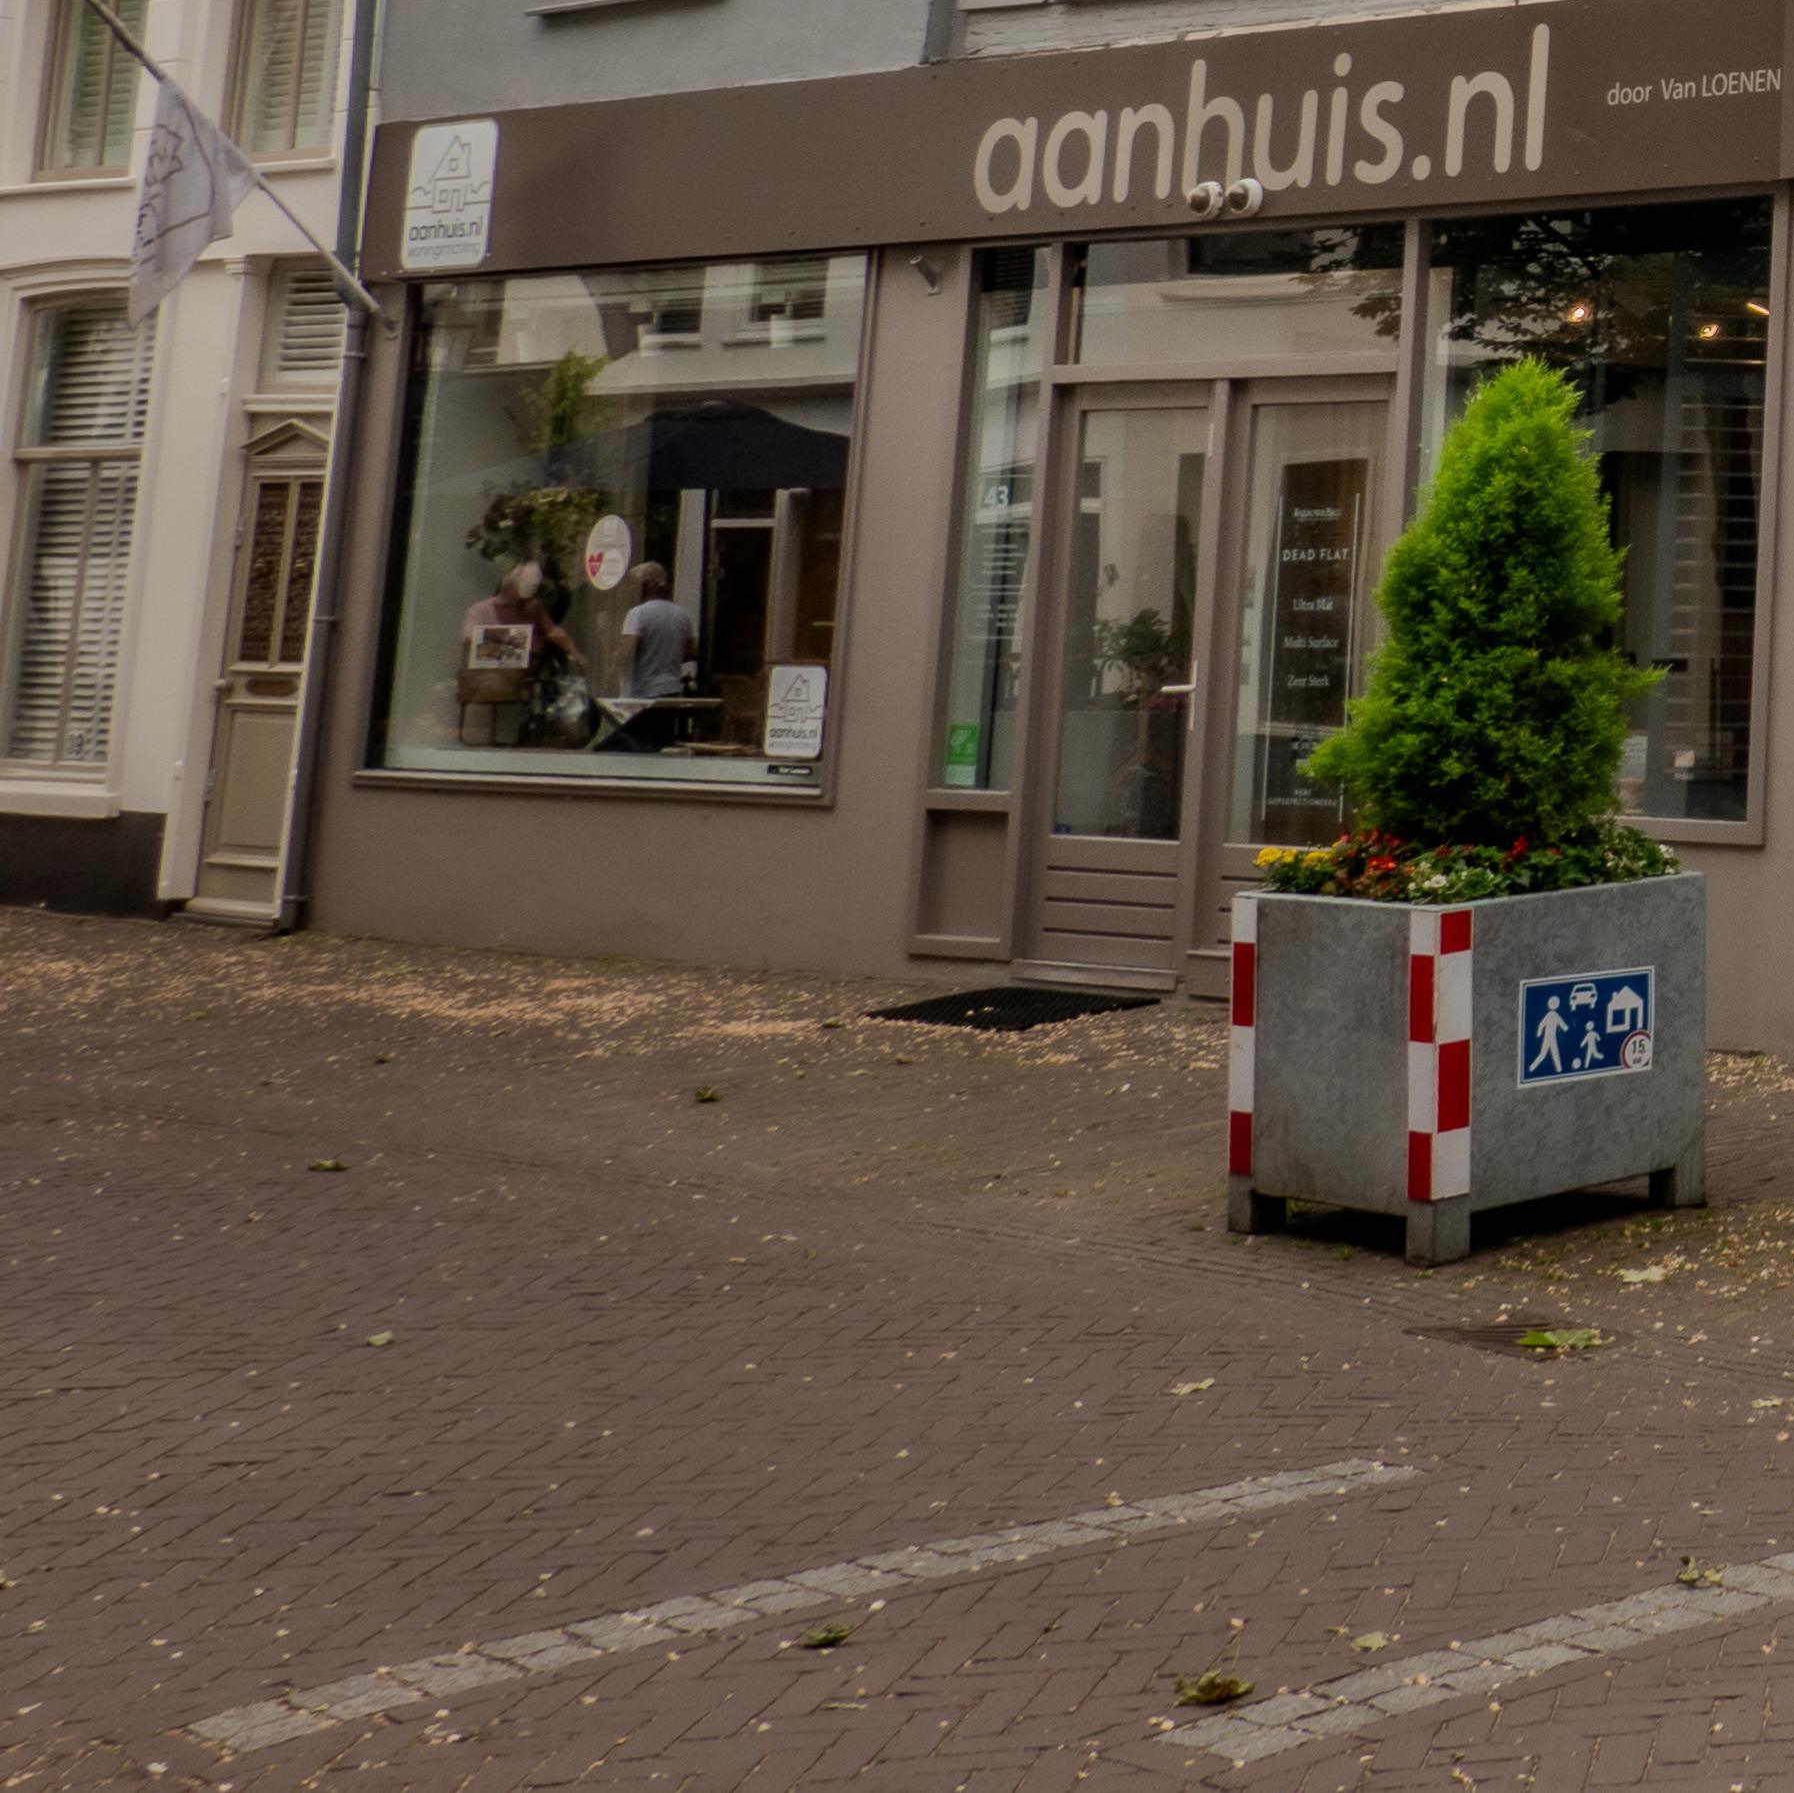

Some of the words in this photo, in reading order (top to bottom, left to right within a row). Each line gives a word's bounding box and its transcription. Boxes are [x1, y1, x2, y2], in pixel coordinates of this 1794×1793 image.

[1607, 82, 1652, 106] door
[1660, 76, 1697, 100] Van
[1701, 68, 1782, 98] LOENEN
[973, 23, 1551, 213] aanhuis.nl
[1282, 548, 1316, 562] DEAD
[1319, 547, 1349, 561] FLAT
[1631, 1038, 1647, 1055] 15
